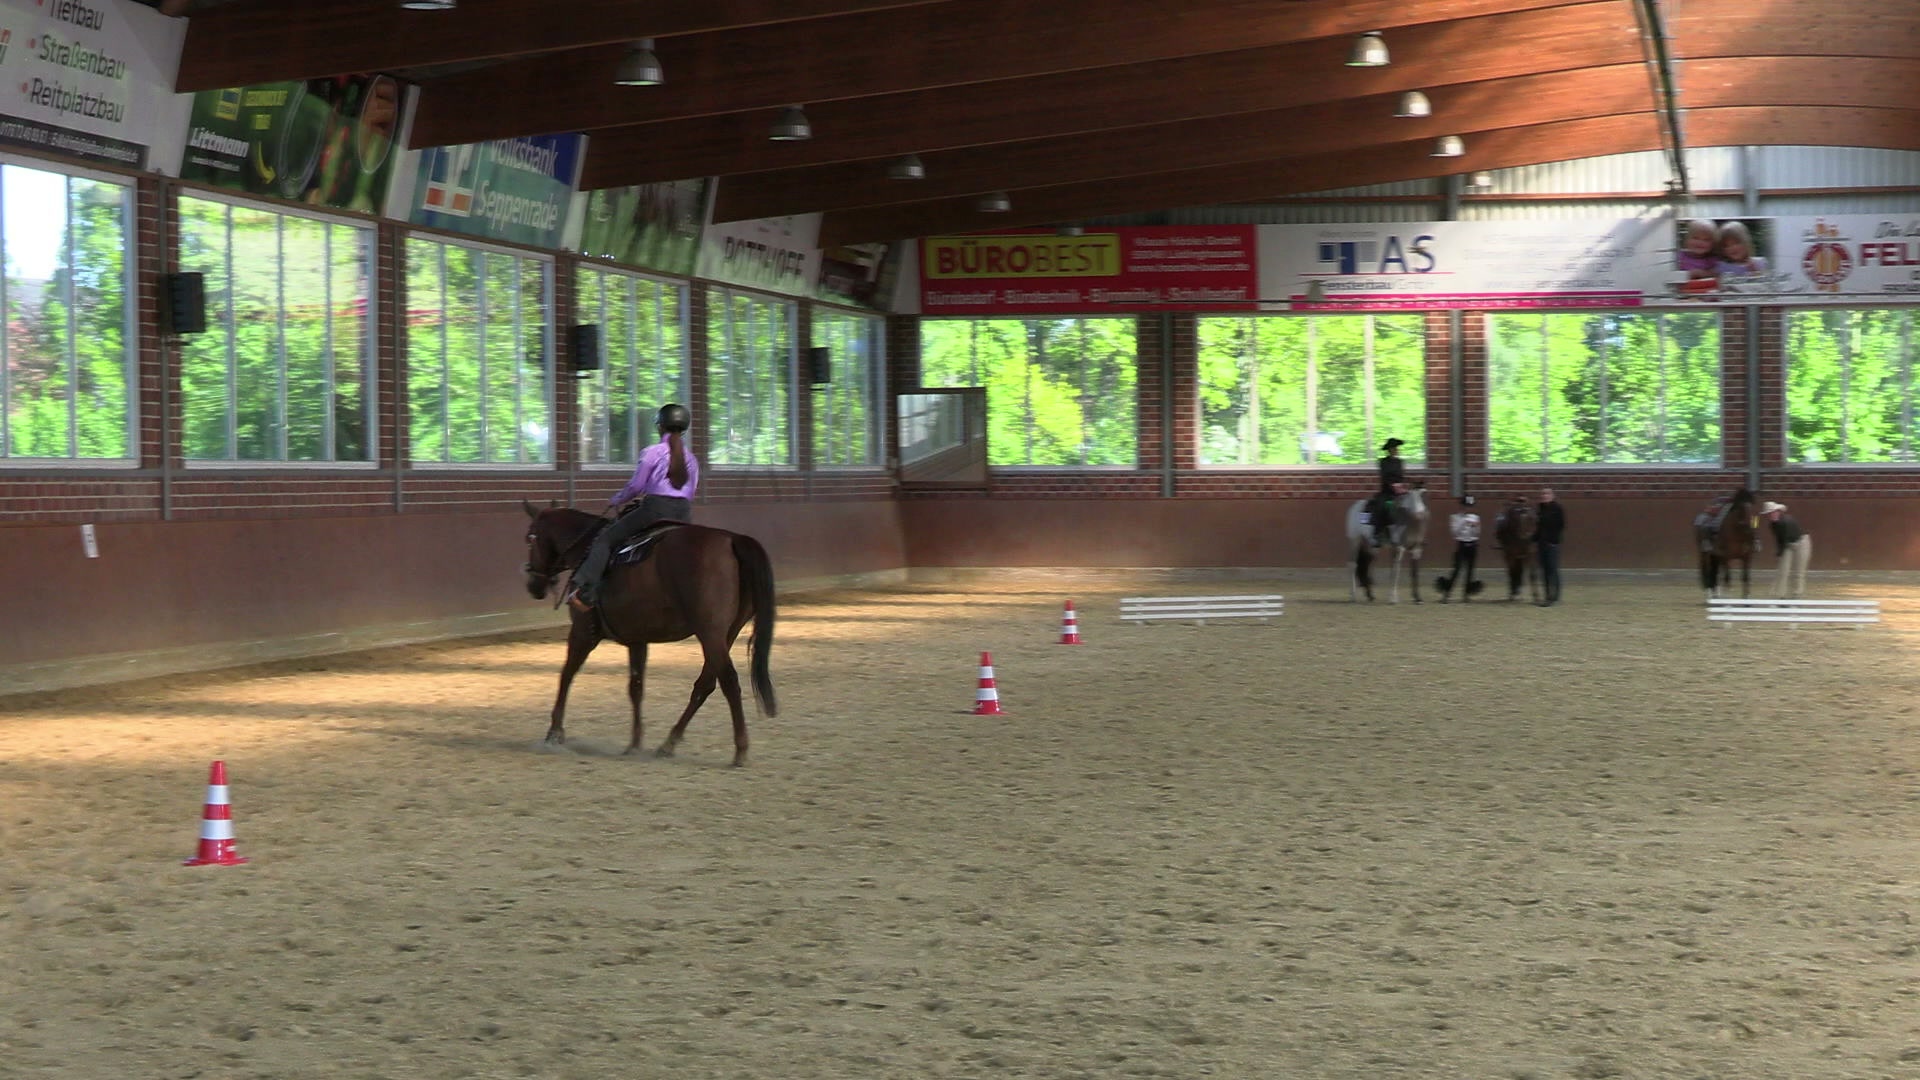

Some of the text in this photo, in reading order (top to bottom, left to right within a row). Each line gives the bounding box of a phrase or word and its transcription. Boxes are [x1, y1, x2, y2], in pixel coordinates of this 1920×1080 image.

[39, 34, 126, 80] Straßenbau
[30, 78, 125, 123] Reitplatzbau
[477, 180, 559, 231] Seppenrade
[936, 241, 1111, 273] BÜROBEST
[1379, 235, 1436, 273] AS
